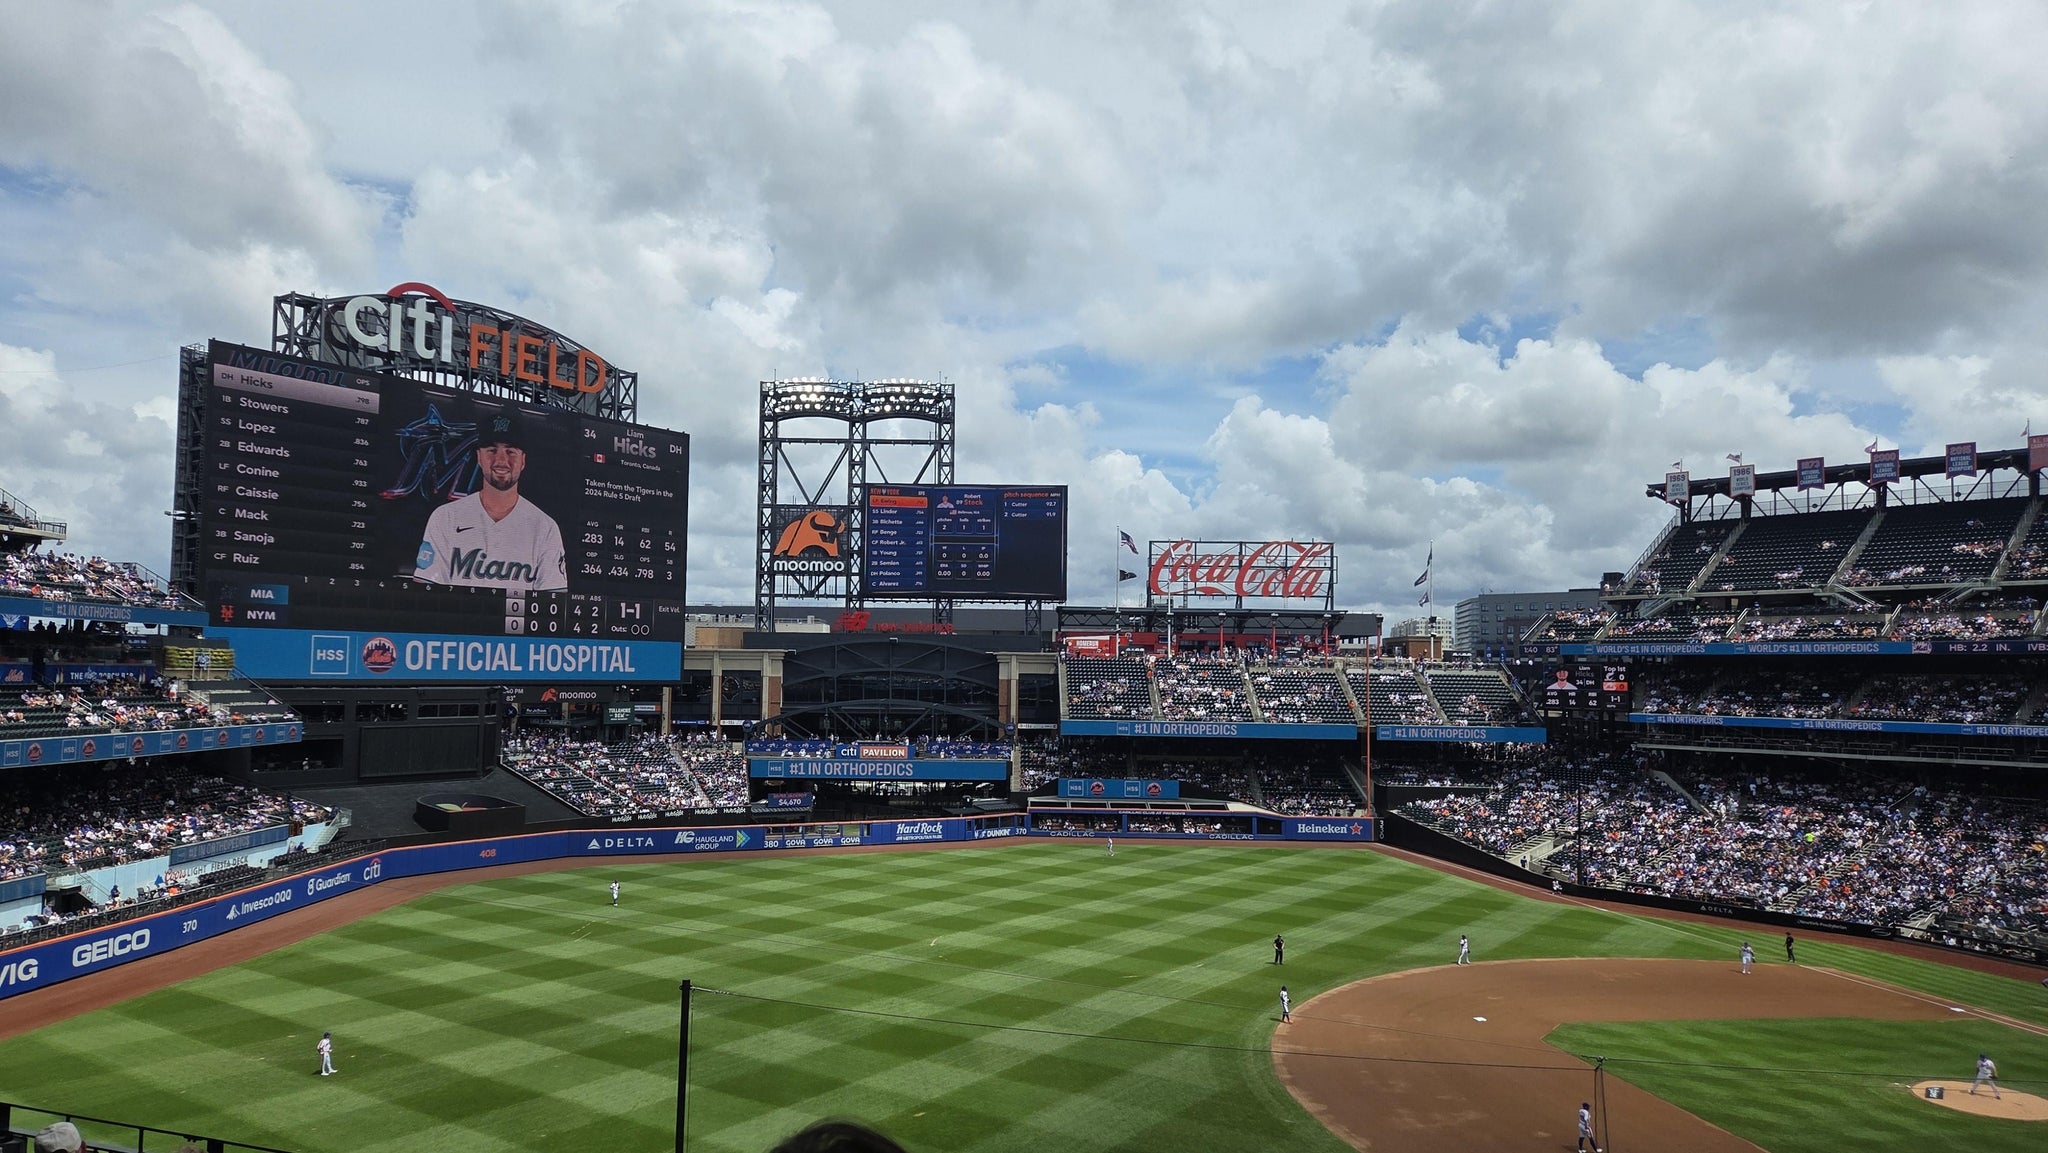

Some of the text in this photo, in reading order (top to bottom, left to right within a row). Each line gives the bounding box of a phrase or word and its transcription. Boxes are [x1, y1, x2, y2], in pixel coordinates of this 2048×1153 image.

[345, 296, 606, 394] citi FIELD
[221, 372, 273, 389] DH Hicks
[240, 397, 288, 414] Stowers
[238, 419, 276, 434] Lopez
[626, 429, 644, 438] Liam
[584, 429, 596, 439] 34
[238, 442, 290, 458] Edwards
[614, 436, 657, 458] Hicks
[670, 444, 682, 454] DH
[236, 464, 280, 478] Conine
[620, 460, 661, 472] Toronto, Canada
[236, 486, 280, 500] Caissie
[585, 478, 674, 498] Taken from the Tigers in the
[585, 488, 602, 497] 2024
[604, 491, 618, 499] Rule
[624, 494, 641, 502] Draft
[234, 508, 269, 521] Mack
[234, 531, 274, 545] Sanoja
[582, 534, 676, 552] .283 14 62 54
[233, 554, 260, 564] Ruiz
[774, 560, 845, 572] moomoo
[581, 564, 672, 580] .364 .434 .798 3
[1150, 540, 1333, 596] Coca-Cola
[250, 589, 274, 599] MIA
[574, 606, 581, 616] 4
[592, 606, 598, 616] 2
[621, 602, 640, 619] 1-1
[57, 604, 131, 619] #1 IN ORTHOPEDICS
[246, 610, 276, 620] NYM
[574, 623, 580, 632] 4
[592, 624, 598, 634] 2
[1650, 645, 1705, 653] ORTHOPEDICS
[1748, 644, 1788, 652] WORLD'S
[1814, 644, 1879, 652] ORTHOPEDICS
[317, 641, 635, 672] HSS OFFICIAL HOSPITAL
[1134, 724, 1237, 735] #1 IN ORTHOPEDICS
[1396, 728, 1486, 739] #1 IN ORTHOPEDICS
[1826, 722, 1882, 731] ORTHOPEDICS
[1990, 727, 2000, 735] IN
[842, 748, 856, 756] citi
[790, 762, 913, 776] #1 IN ORTHOPEDICS
[897, 822, 942, 834] Hard Rock
[987, 828, 1010, 837] DUNKIN'
[1298, 823, 1348, 834] Heineken
[605, 837, 654, 848] DELTA
[480, 849, 496, 858] 408
[187, 856, 248, 877] LIGHT FIESTA DECK
[364, 861, 381, 880] citi
[316, 873, 351, 890] Guardian
[242, 889, 292, 914] Invesco QQQ
[182, 920, 198, 934] 370
[72, 928, 150, 968] GEICO
